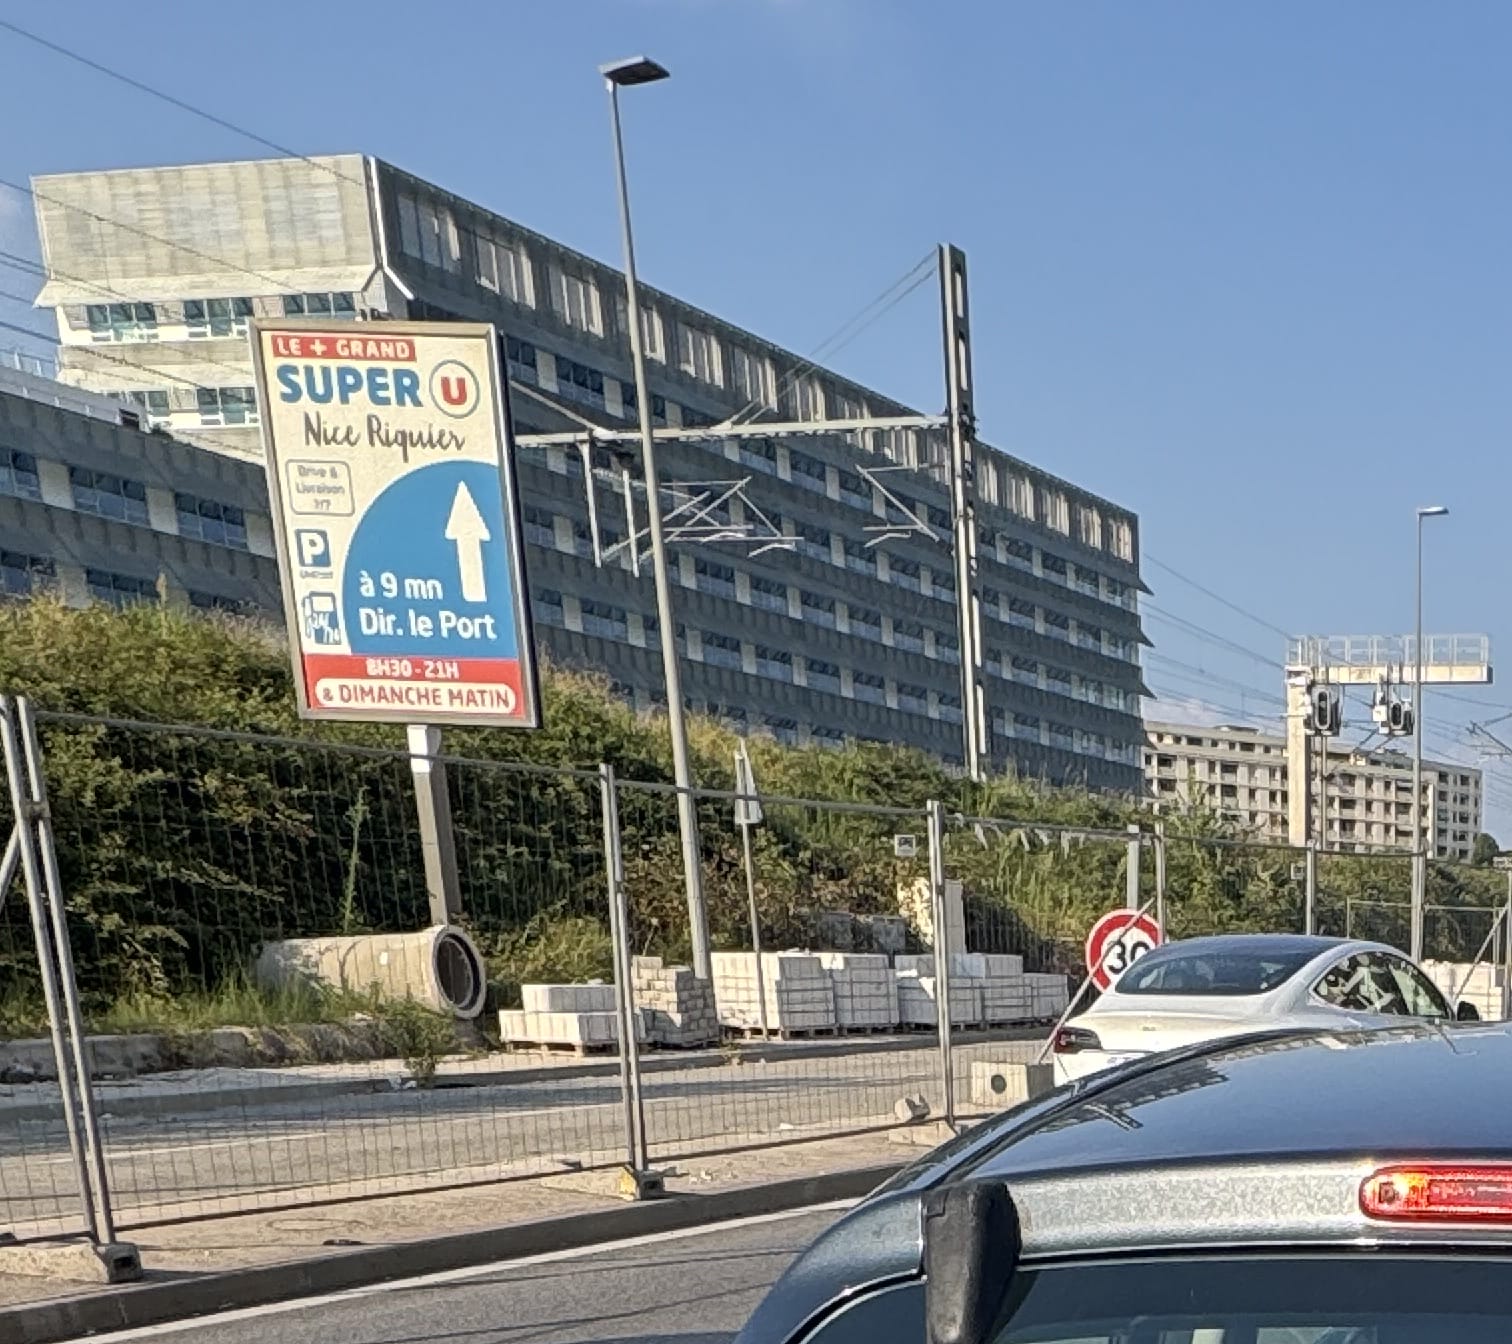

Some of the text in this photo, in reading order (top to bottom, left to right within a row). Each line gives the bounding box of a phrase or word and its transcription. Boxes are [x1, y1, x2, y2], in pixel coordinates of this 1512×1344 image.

[277, 337, 301, 355] LE
[336, 339, 410, 358] GRAND
[277, 364, 467, 407] SUPER U
[304, 410, 465, 463] Nice Riquier
[301, 532, 325, 564] P
[360, 570, 443, 600] à 9 mn
[359, 607, 403, 636] Dir.
[408, 608, 433, 637] le
[439, 610, 498, 640] Port
[338, 683, 442, 706] DIMANCHE
[447, 688, 510, 709] MATIN
